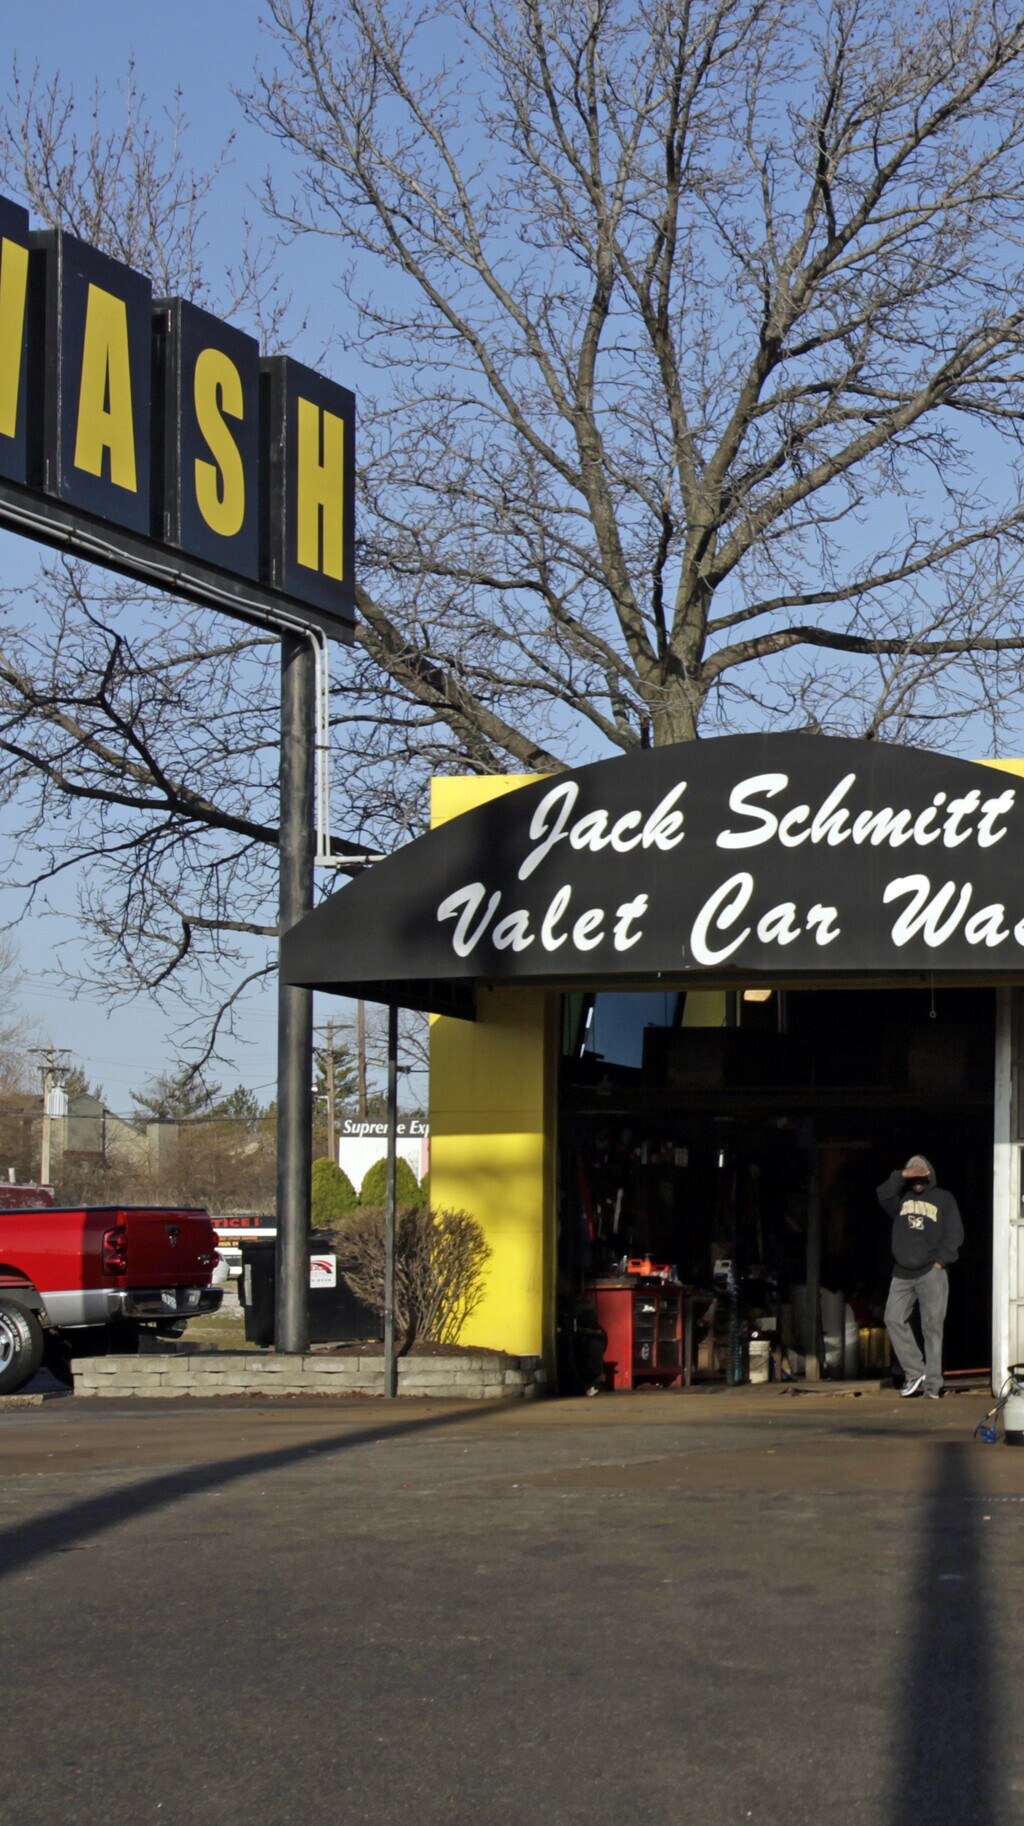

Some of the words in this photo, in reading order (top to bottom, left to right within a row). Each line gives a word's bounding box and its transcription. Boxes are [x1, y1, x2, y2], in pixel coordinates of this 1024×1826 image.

[518, 781, 687, 880] Jack
[716, 773, 1015, 849] Schmitt
[437, 882, 648, 957] Valet
[690, 872, 840, 965] Car
[211, 1218, 251, 1228] TICE
